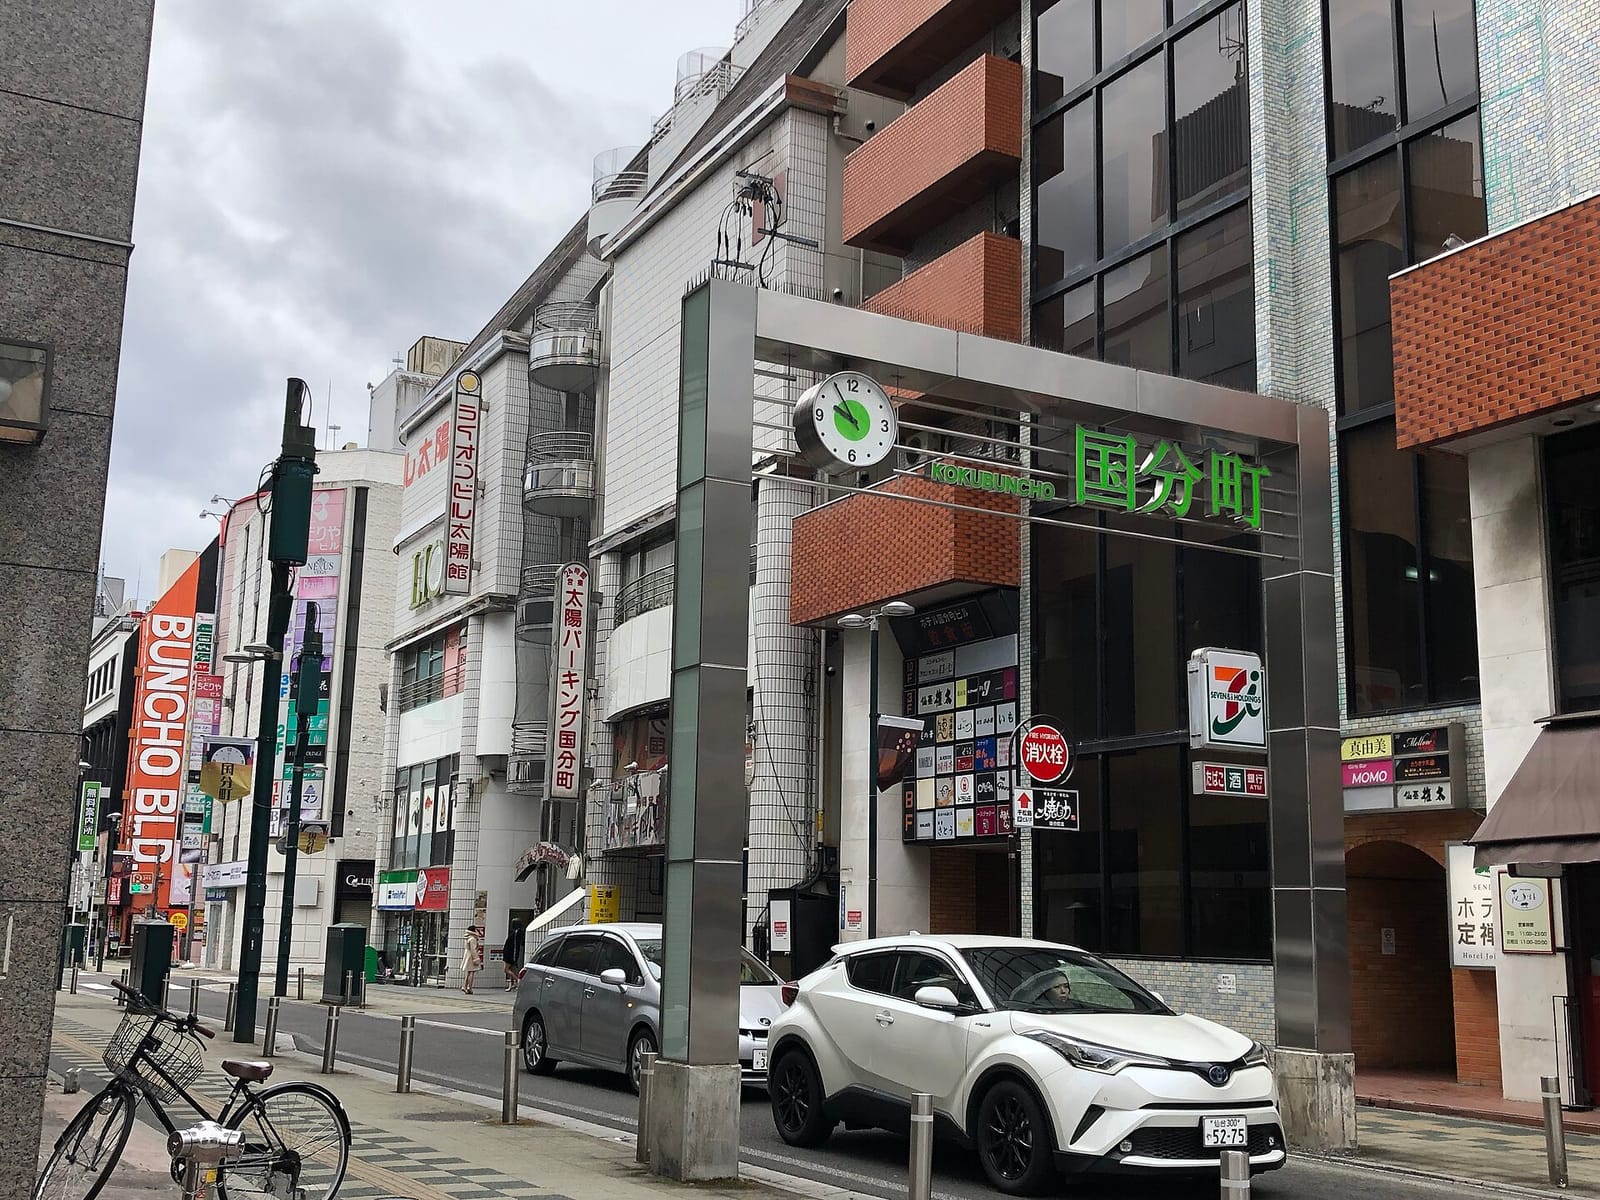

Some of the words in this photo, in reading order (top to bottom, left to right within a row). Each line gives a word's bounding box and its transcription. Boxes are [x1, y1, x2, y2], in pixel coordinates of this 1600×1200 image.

[847, 380, 859, 392] 12
[816, 408, 824, 421] 9
[881, 420, 889, 432] 3
[848, 450, 857, 462] 6
[930, 462, 1056, 501] KOKUBUNCHO
[1076, 423, 1271, 530] 国分町
[307, 558, 334, 571] NEXUS
[139, 614, 193, 776] BUNCHO
[280, 674, 289, 697] 3F
[557, 588, 584, 789] 太陽パーキング国分町
[1233, 692, 1261, 704] HOLDINGS
[276, 724, 285, 755] 2F
[1040, 732, 1060, 740] HYDRANT
[1350, 738, 1386, 757] 真由美
[1025, 741, 1065, 765] 消火栓
[219, 762, 234, 800] 国分町
[1206, 770, 1225, 788] たばこ
[1229, 771, 1241, 789] 酒
[1247, 773, 1264, 784] 銀行
[1352, 770, 1388, 784] MOMO
[271, 782, 279, 806] 1F
[83, 788, 97, 835] 無料案内所
[269, 811, 278, 834] B1
[131, 788, 177, 871] BLD.
[1213, 1129, 1245, 1144] 52-75
